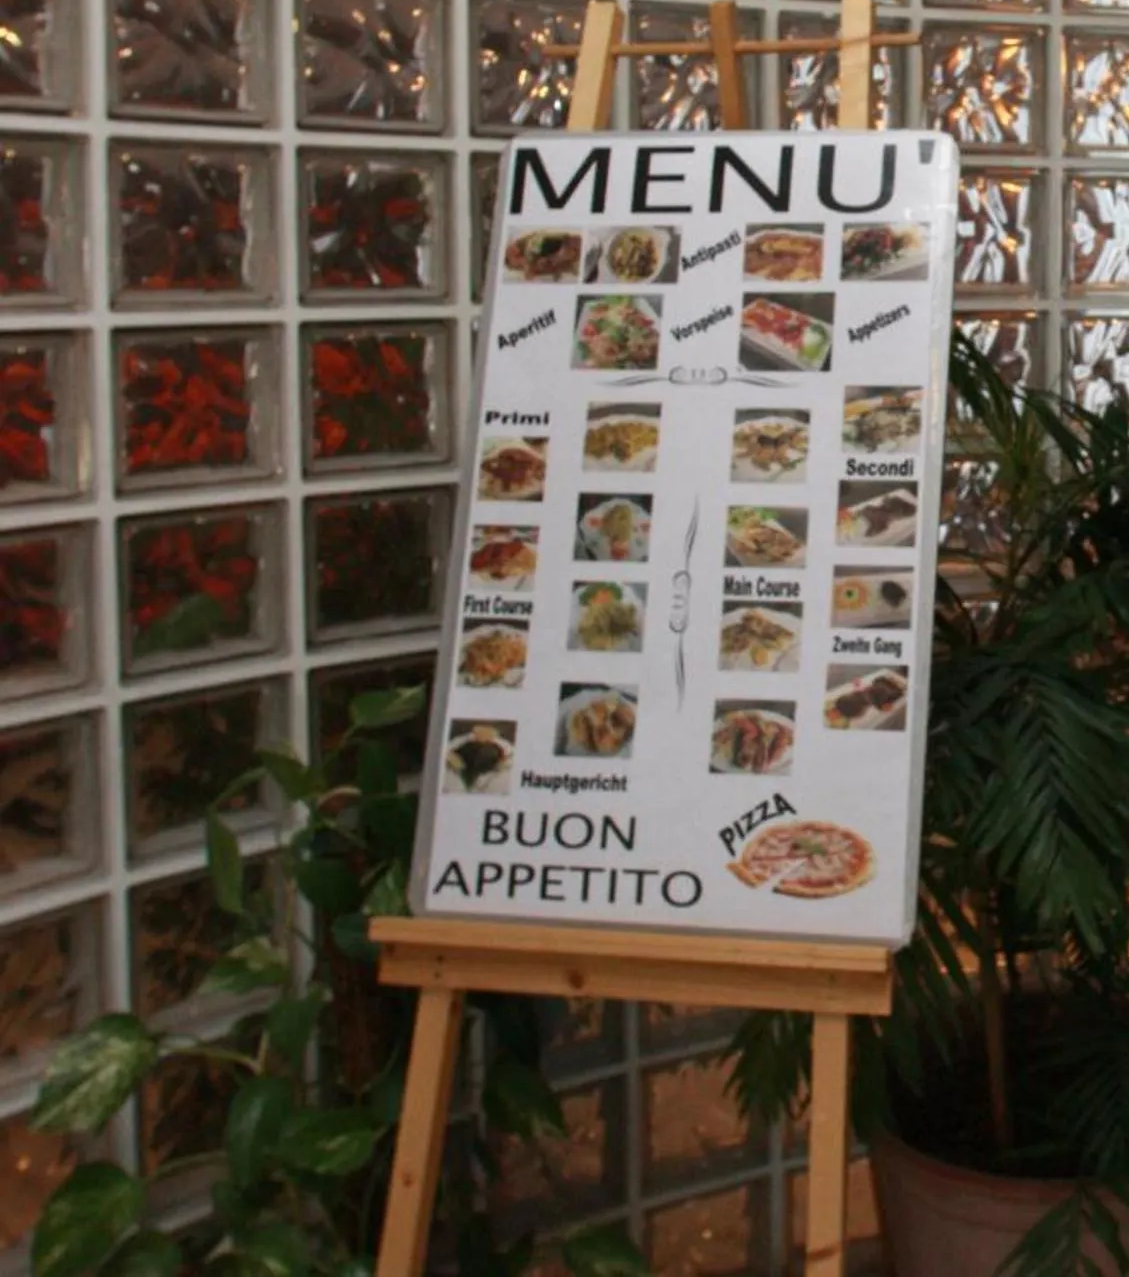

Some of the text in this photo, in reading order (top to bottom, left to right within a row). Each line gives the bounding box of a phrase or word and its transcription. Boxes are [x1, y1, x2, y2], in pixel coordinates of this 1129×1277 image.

[681, 230, 741, 271] Antipasti
[498, 309, 556, 350] Aperitif
[670, 305, 734, 342] Vorspeise
[847, 304, 911, 343] Appetizers
[485, 411, 550, 425] Primi
[846, 459, 914, 476] Secondi
[463, 595, 533, 615] First Course
[723, 575, 800, 598] Main Course
[874, 637, 903, 659] Gang
[520, 769, 628, 794] Hauptgericht
[481, 809, 637, 851] BUON
[719, 793, 797, 855] PIZZA
[433, 860, 702, 908] APPETITO
